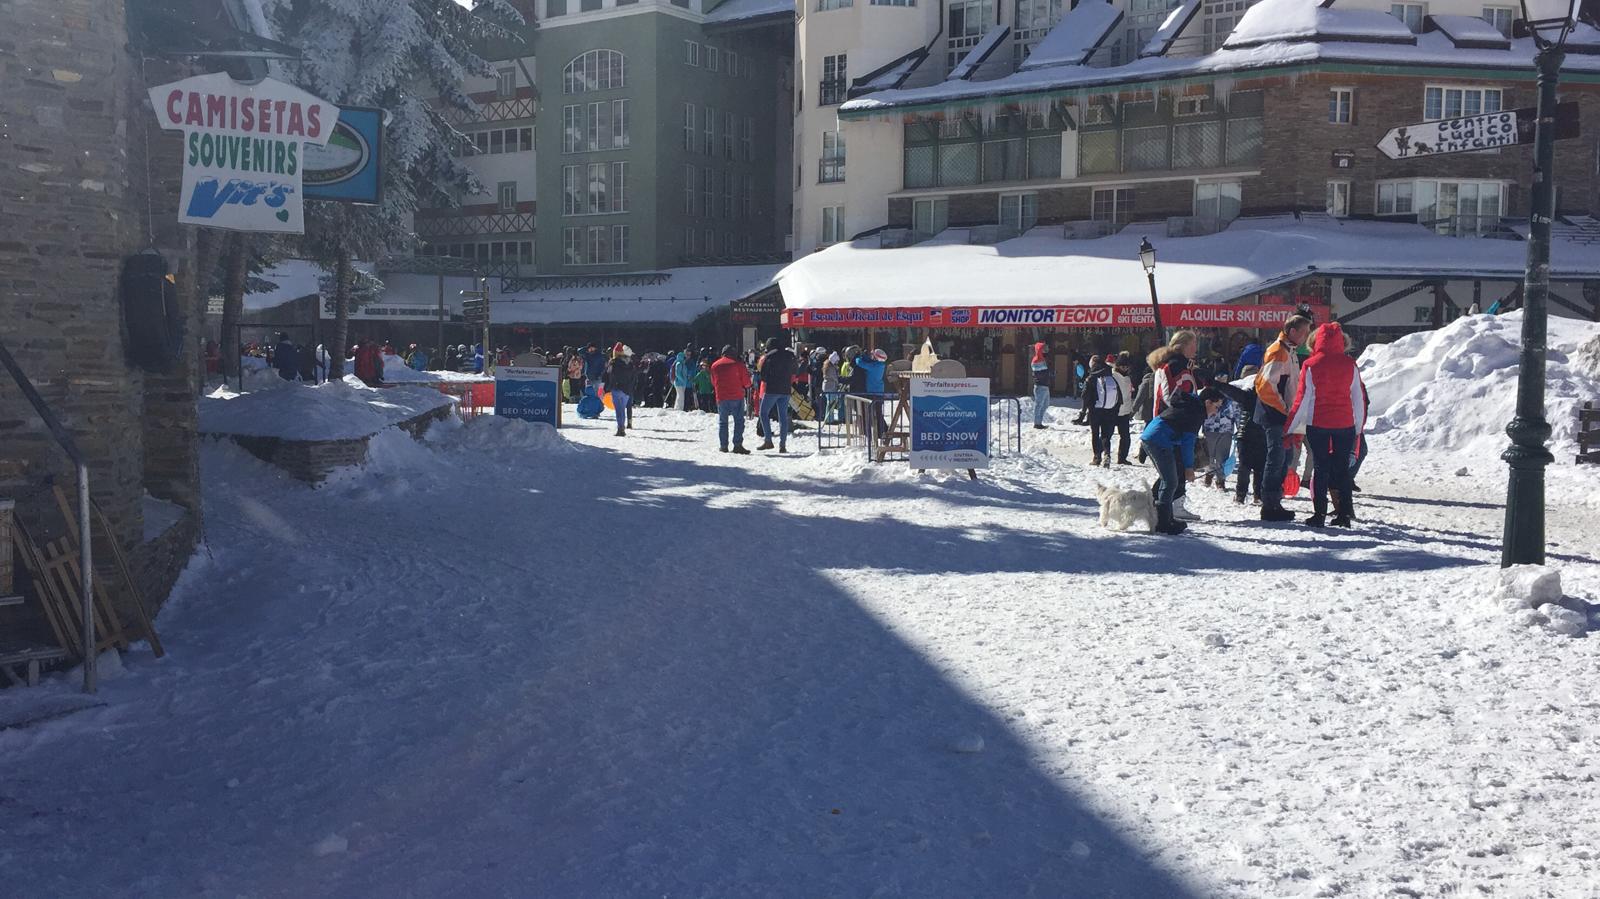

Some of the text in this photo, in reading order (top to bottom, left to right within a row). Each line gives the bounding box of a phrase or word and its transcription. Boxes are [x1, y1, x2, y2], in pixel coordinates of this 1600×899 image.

[166, 89, 321, 138] CAMISETAS
[1438, 123, 1513, 143] Lúdico
[1435, 133, 1517, 153] Infantil
[188, 131, 298, 176] SOUVENIRS
[810, 310, 844, 322] Escuela
[846, 309, 880, 322] Oficial
[882, 310, 894, 322] de
[980, 308, 1110, 323] MONITORTECNO
[1117, 315, 1156, 323] SKI RENTA
[1180, 309, 1235, 322] ALQUILER
[1236, 310, 1255, 322] SKI
[920, 432, 979, 441] BED SNOW
